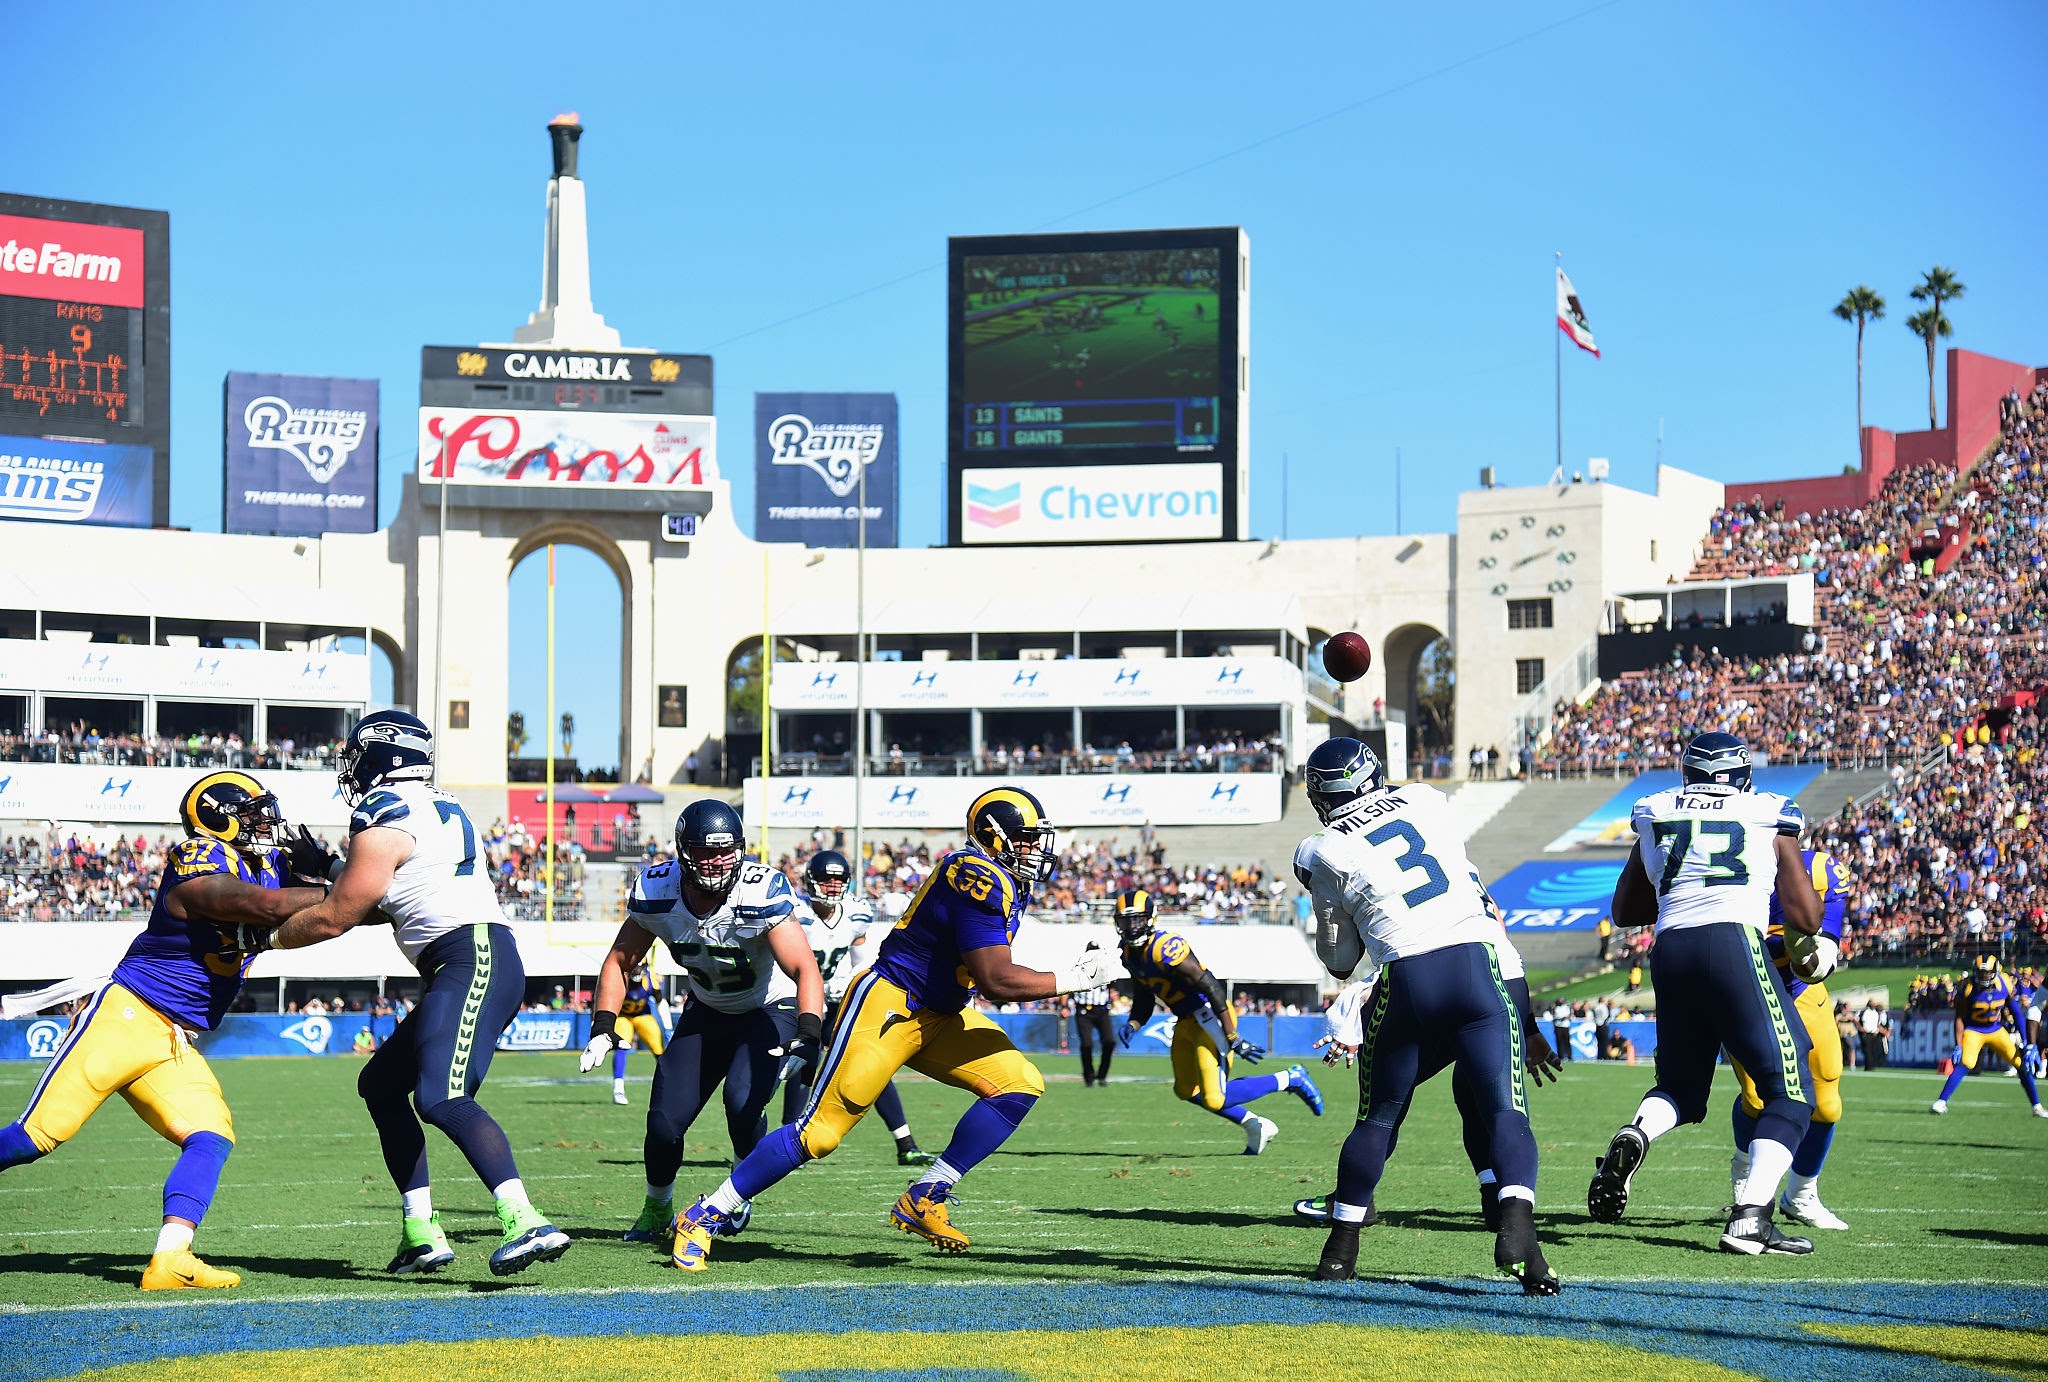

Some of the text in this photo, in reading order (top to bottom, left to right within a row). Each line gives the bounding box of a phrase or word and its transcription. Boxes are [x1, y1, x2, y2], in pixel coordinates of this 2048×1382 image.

[56, 302, 103, 322] RAMS
[70, 324, 92, 353] 9
[503, 353, 632, 381] CAMBRIA
[244, 396, 367, 452] Rams
[976, 406, 1064, 424] 13 SAINTS
[768, 414, 885, 465] Rams
[1014, 429, 1064, 446] GIANTS
[0, 454, 23, 468] OS
[244, 490, 365, 509] THERAMS.COM
[1040, 485, 1218, 521] Chevron
[668, 516, 696, 536] 40
[1331, 796, 1409, 836] WILSON
[180, 839, 218, 863] 97
[1363, 818, 1450, 909] 3
[1652, 818, 1750, 896] 73
[1971, 999, 2006, 1025] 25
[1728, 1216, 1760, 1237] NIKE
